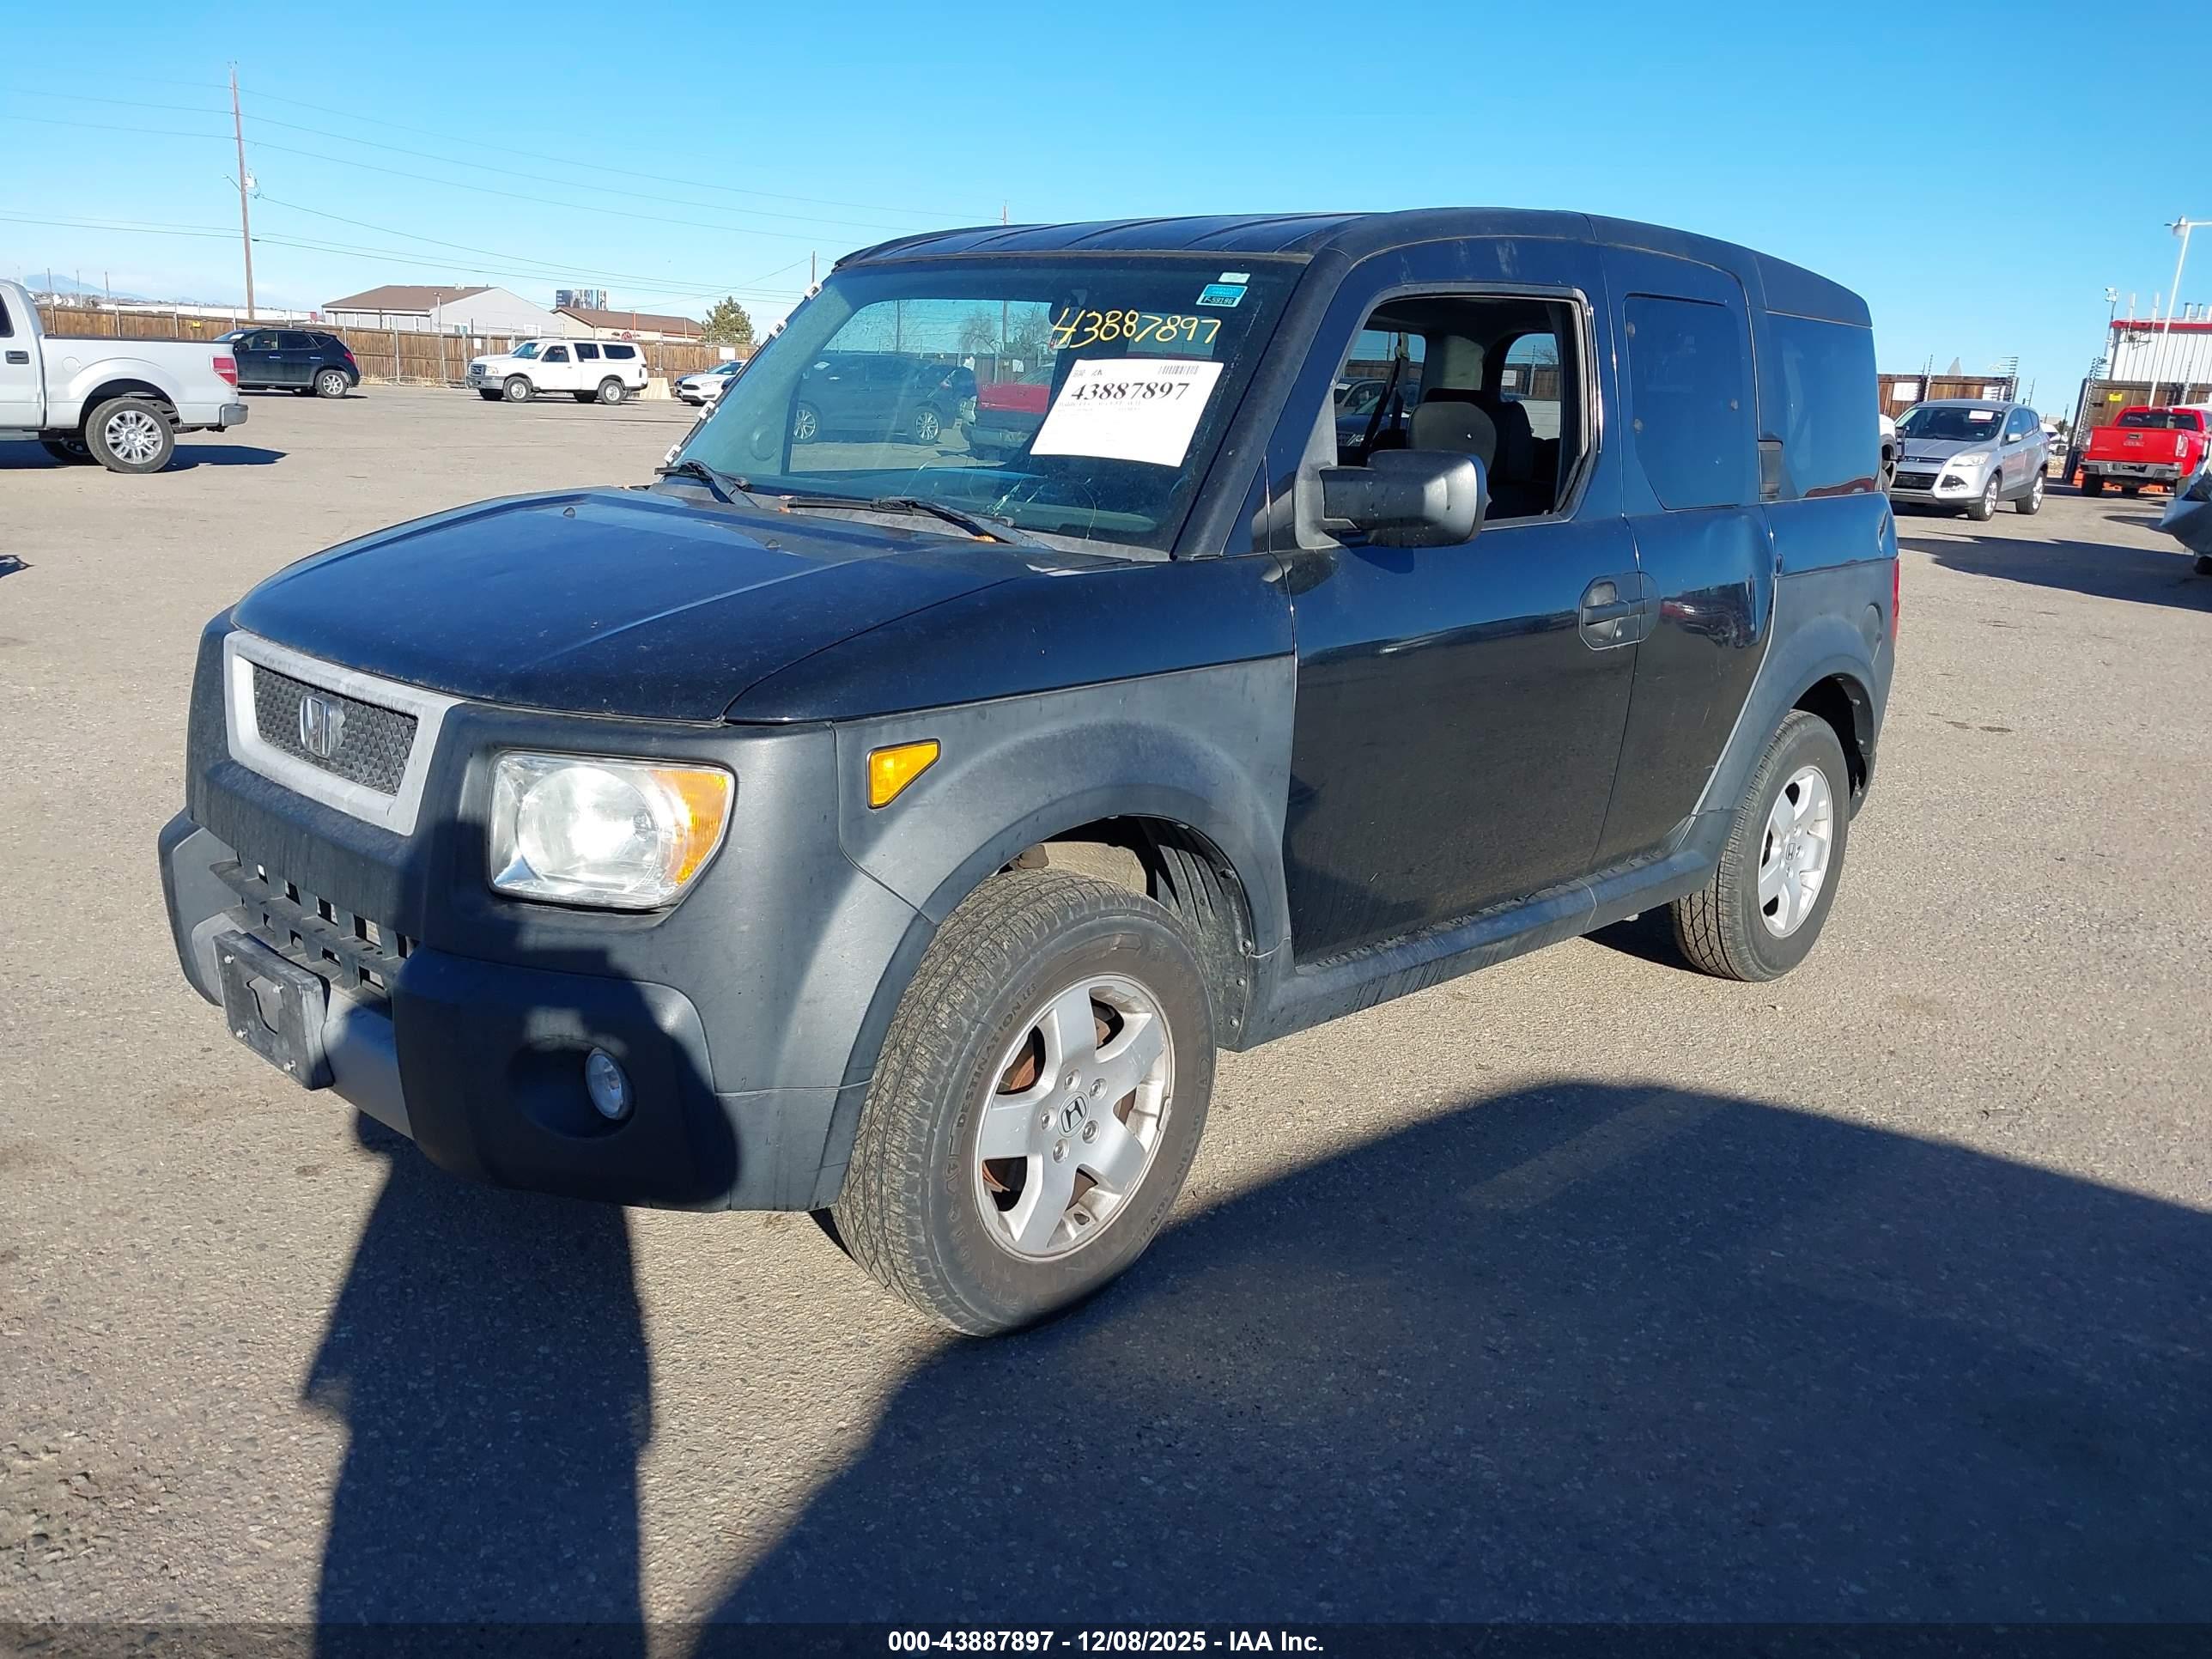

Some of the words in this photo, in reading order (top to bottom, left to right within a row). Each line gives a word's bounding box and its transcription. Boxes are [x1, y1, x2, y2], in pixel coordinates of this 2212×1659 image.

[1053, 307, 1221, 349] 43887897
[1072, 381, 1190, 401] 43887897
[957, 1001, 1022, 1127] DESTINATION
